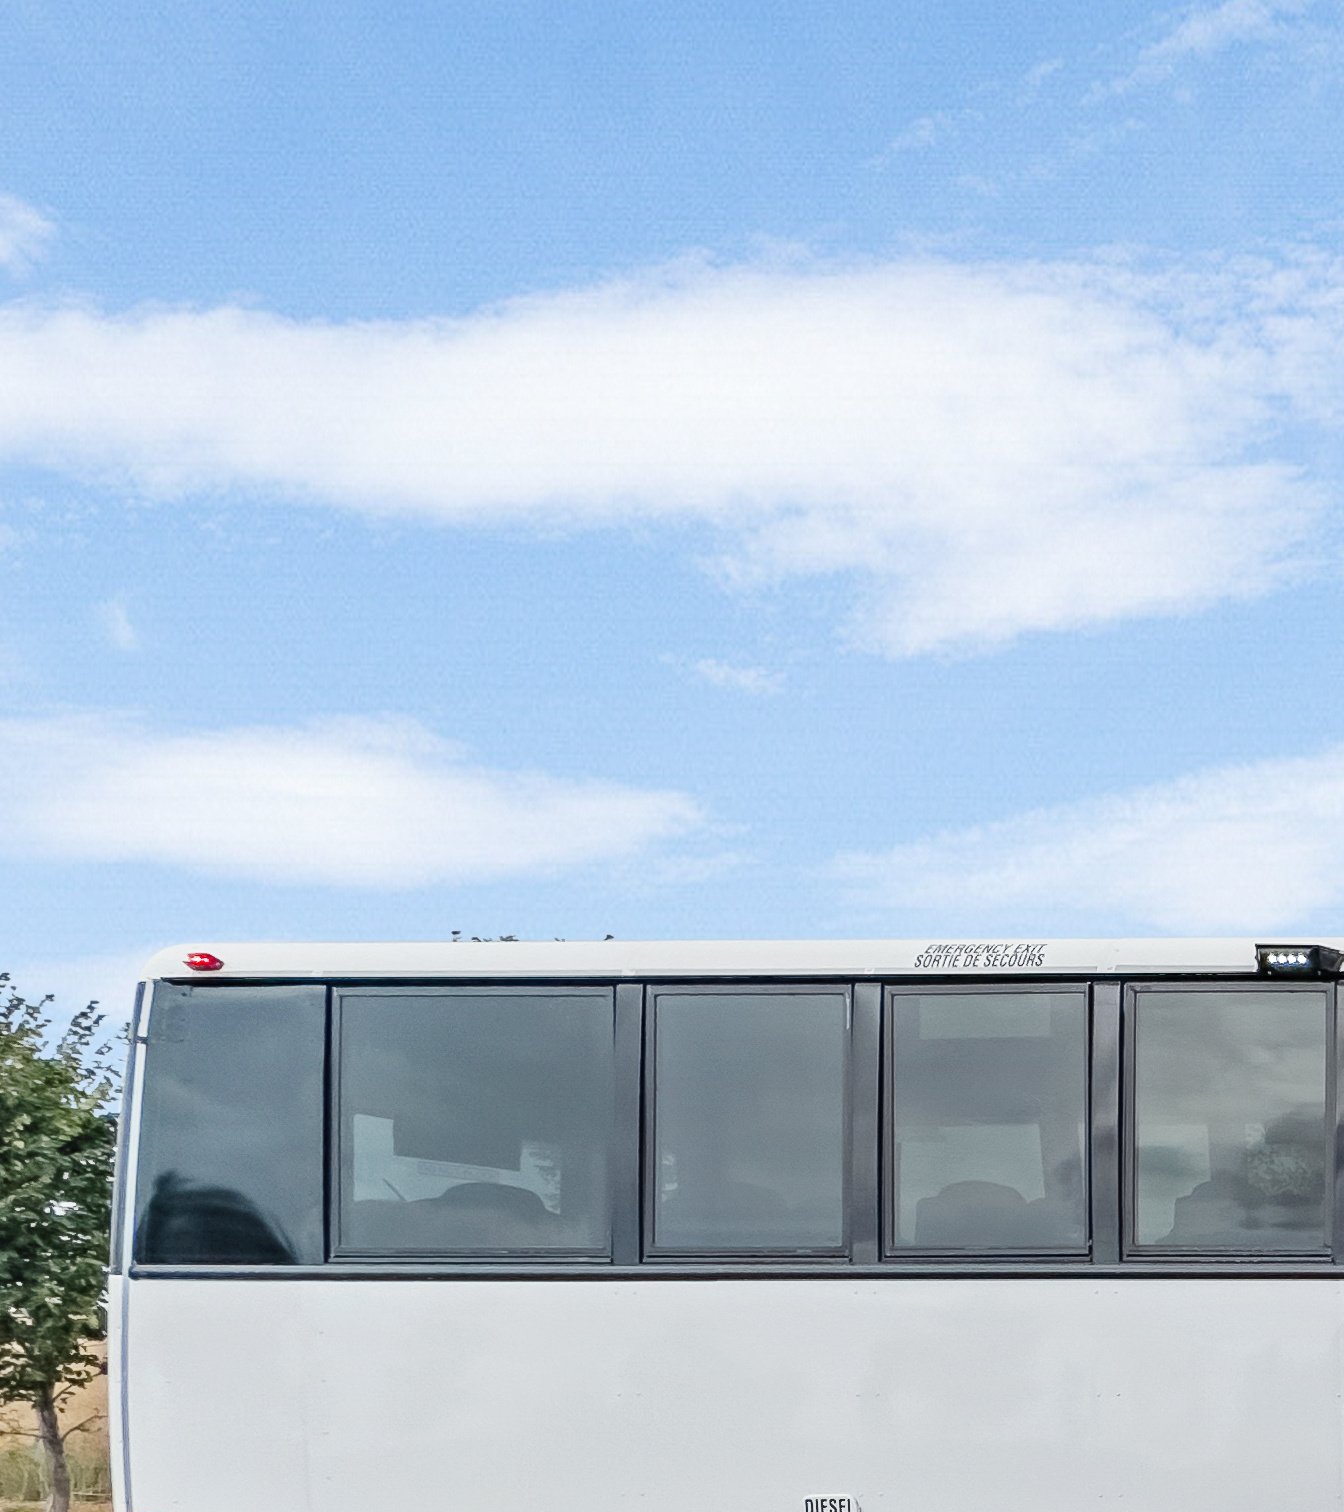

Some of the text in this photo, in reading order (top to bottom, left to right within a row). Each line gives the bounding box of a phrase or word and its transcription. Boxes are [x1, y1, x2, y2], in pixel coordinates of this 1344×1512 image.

[924, 943, 1048, 954] EMERGENCY EXIT
[914, 953, 1045, 968] SORTIE DE SECOURS
